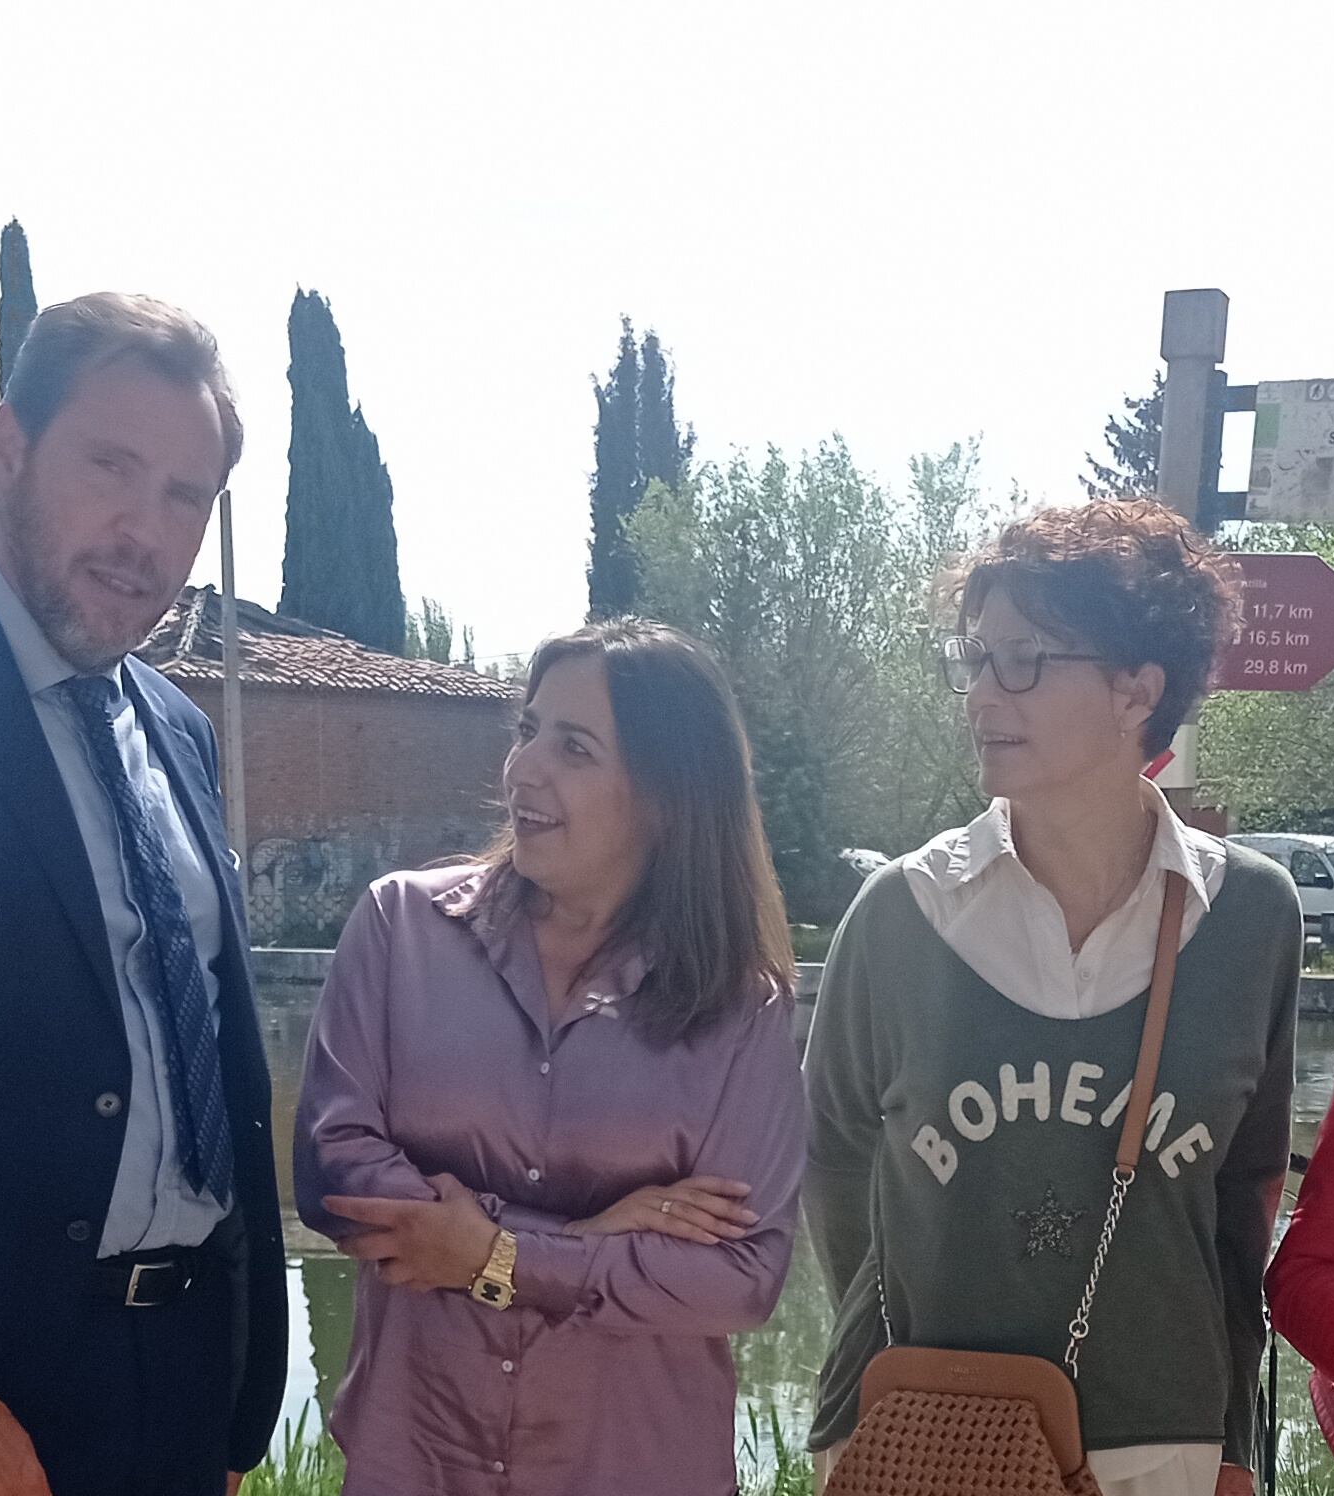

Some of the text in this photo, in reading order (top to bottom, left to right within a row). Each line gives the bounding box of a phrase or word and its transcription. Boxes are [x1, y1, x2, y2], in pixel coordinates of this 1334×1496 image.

[1253, 604, 1313, 621] 11,7 km
[1248, 630, 1310, 647] 16,5 km
[1243, 660, 1308, 677] 29,8 km
